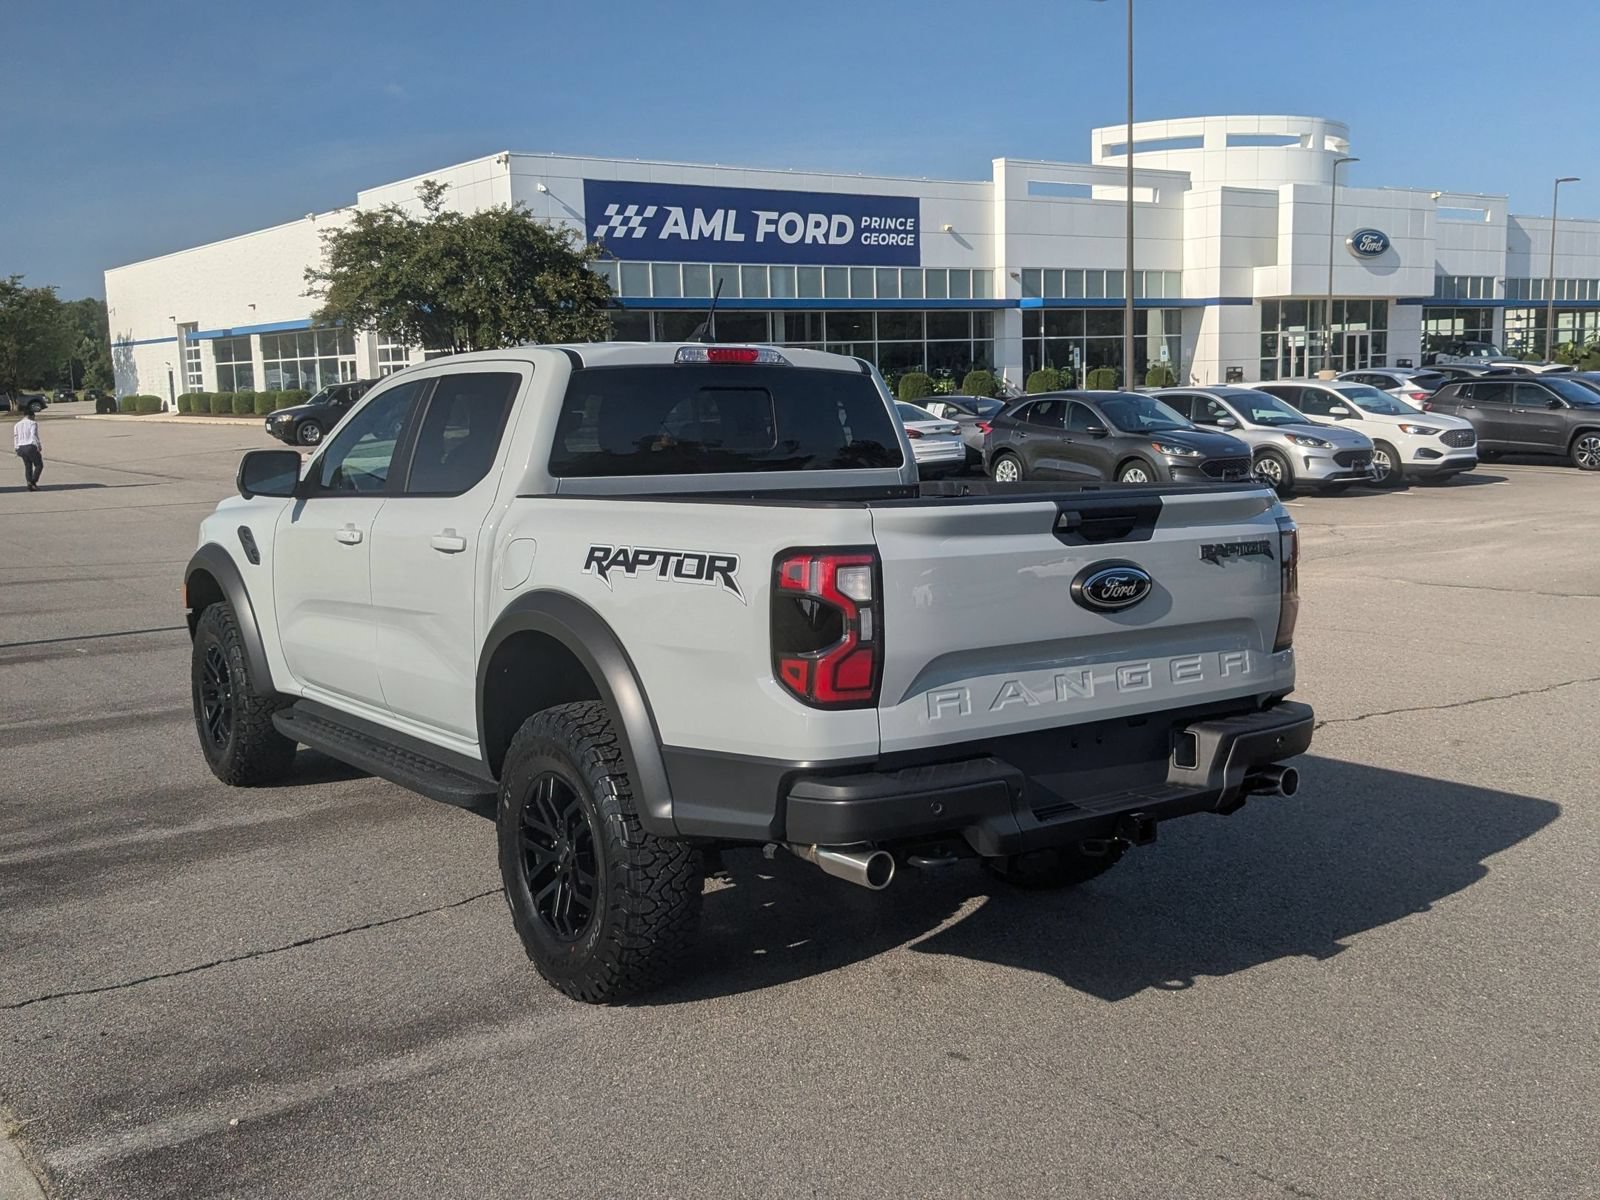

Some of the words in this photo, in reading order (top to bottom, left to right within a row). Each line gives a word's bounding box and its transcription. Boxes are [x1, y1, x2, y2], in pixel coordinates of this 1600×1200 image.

[658, 206, 745, 242] AML
[751, 210, 855, 245] FORD
[860, 216, 915, 230] PRINCE
[860, 232, 915, 246] GEORGE
[1360, 234, 1383, 251] Ford
[1199, 540, 1274, 566] RAPTOR
[581, 543, 747, 607] RAPTOR
[1101, 576, 1136, 598] Ford
[926, 650, 1250, 720] RANGER
